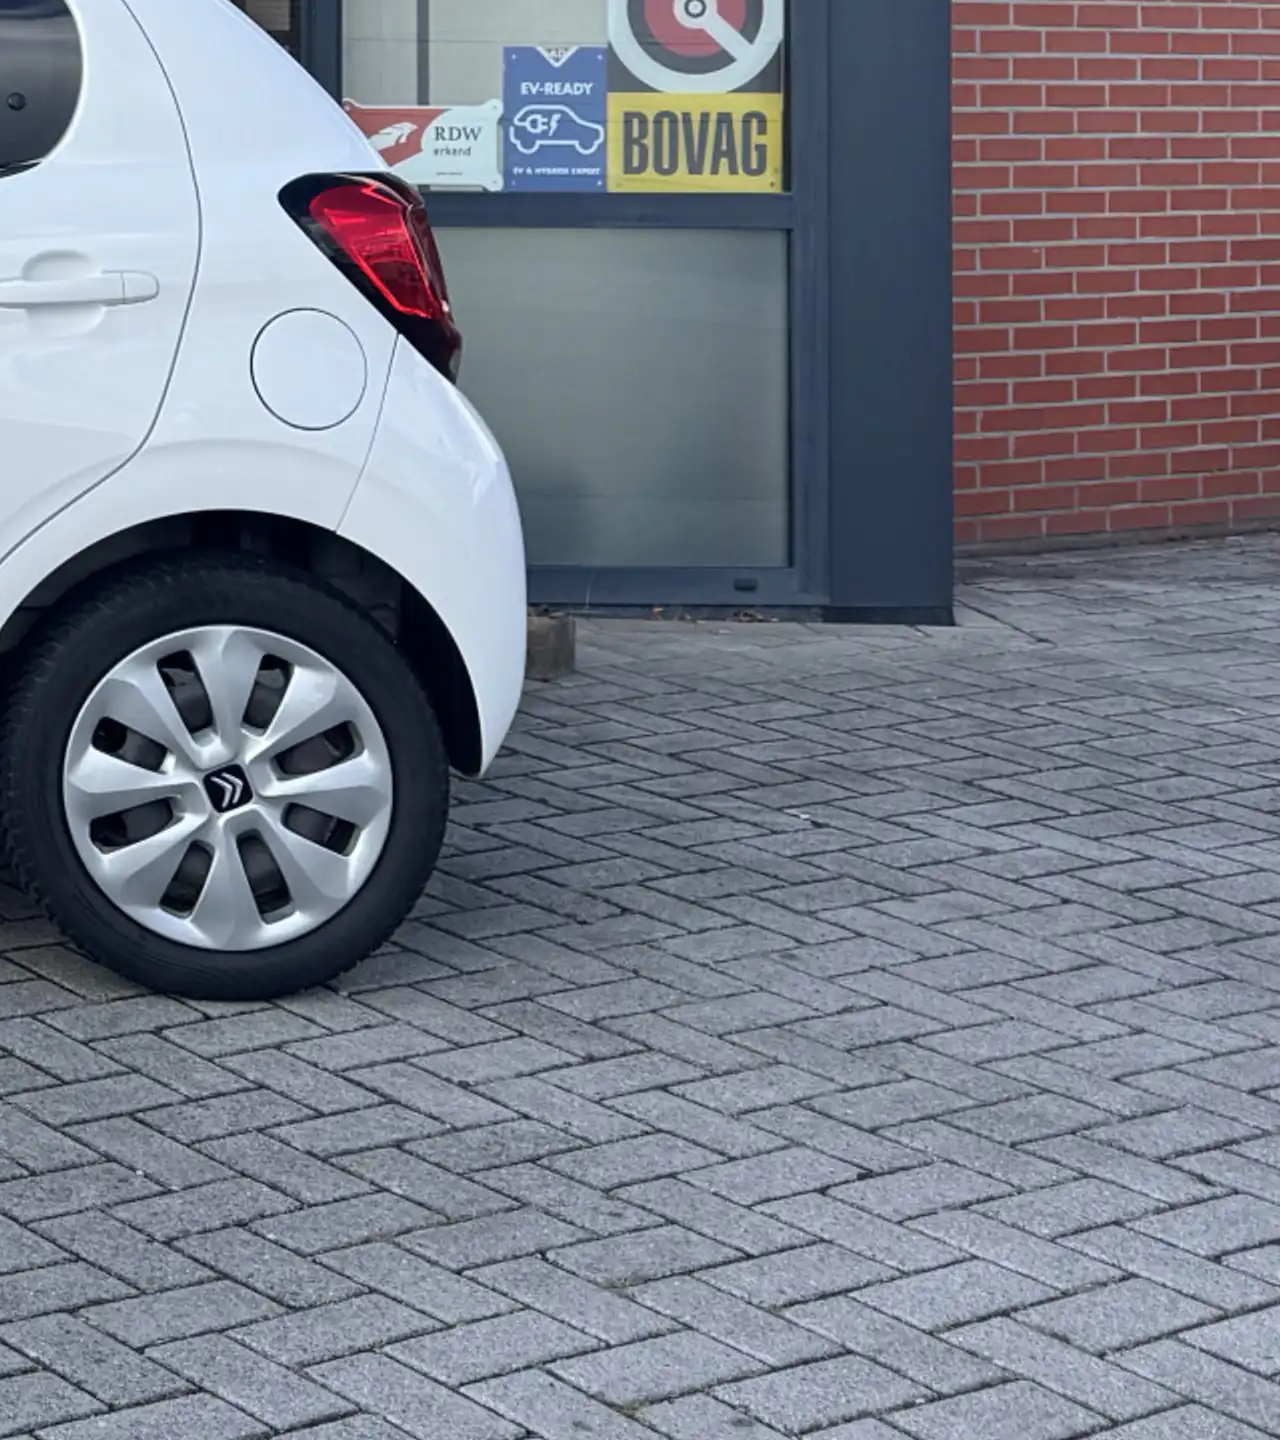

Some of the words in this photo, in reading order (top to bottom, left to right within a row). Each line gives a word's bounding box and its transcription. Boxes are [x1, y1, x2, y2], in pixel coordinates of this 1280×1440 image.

[520, 82, 594, 95] EV-READY
[433, 126, 483, 141] RDW
[623, 110, 768, 176] BOVAG
